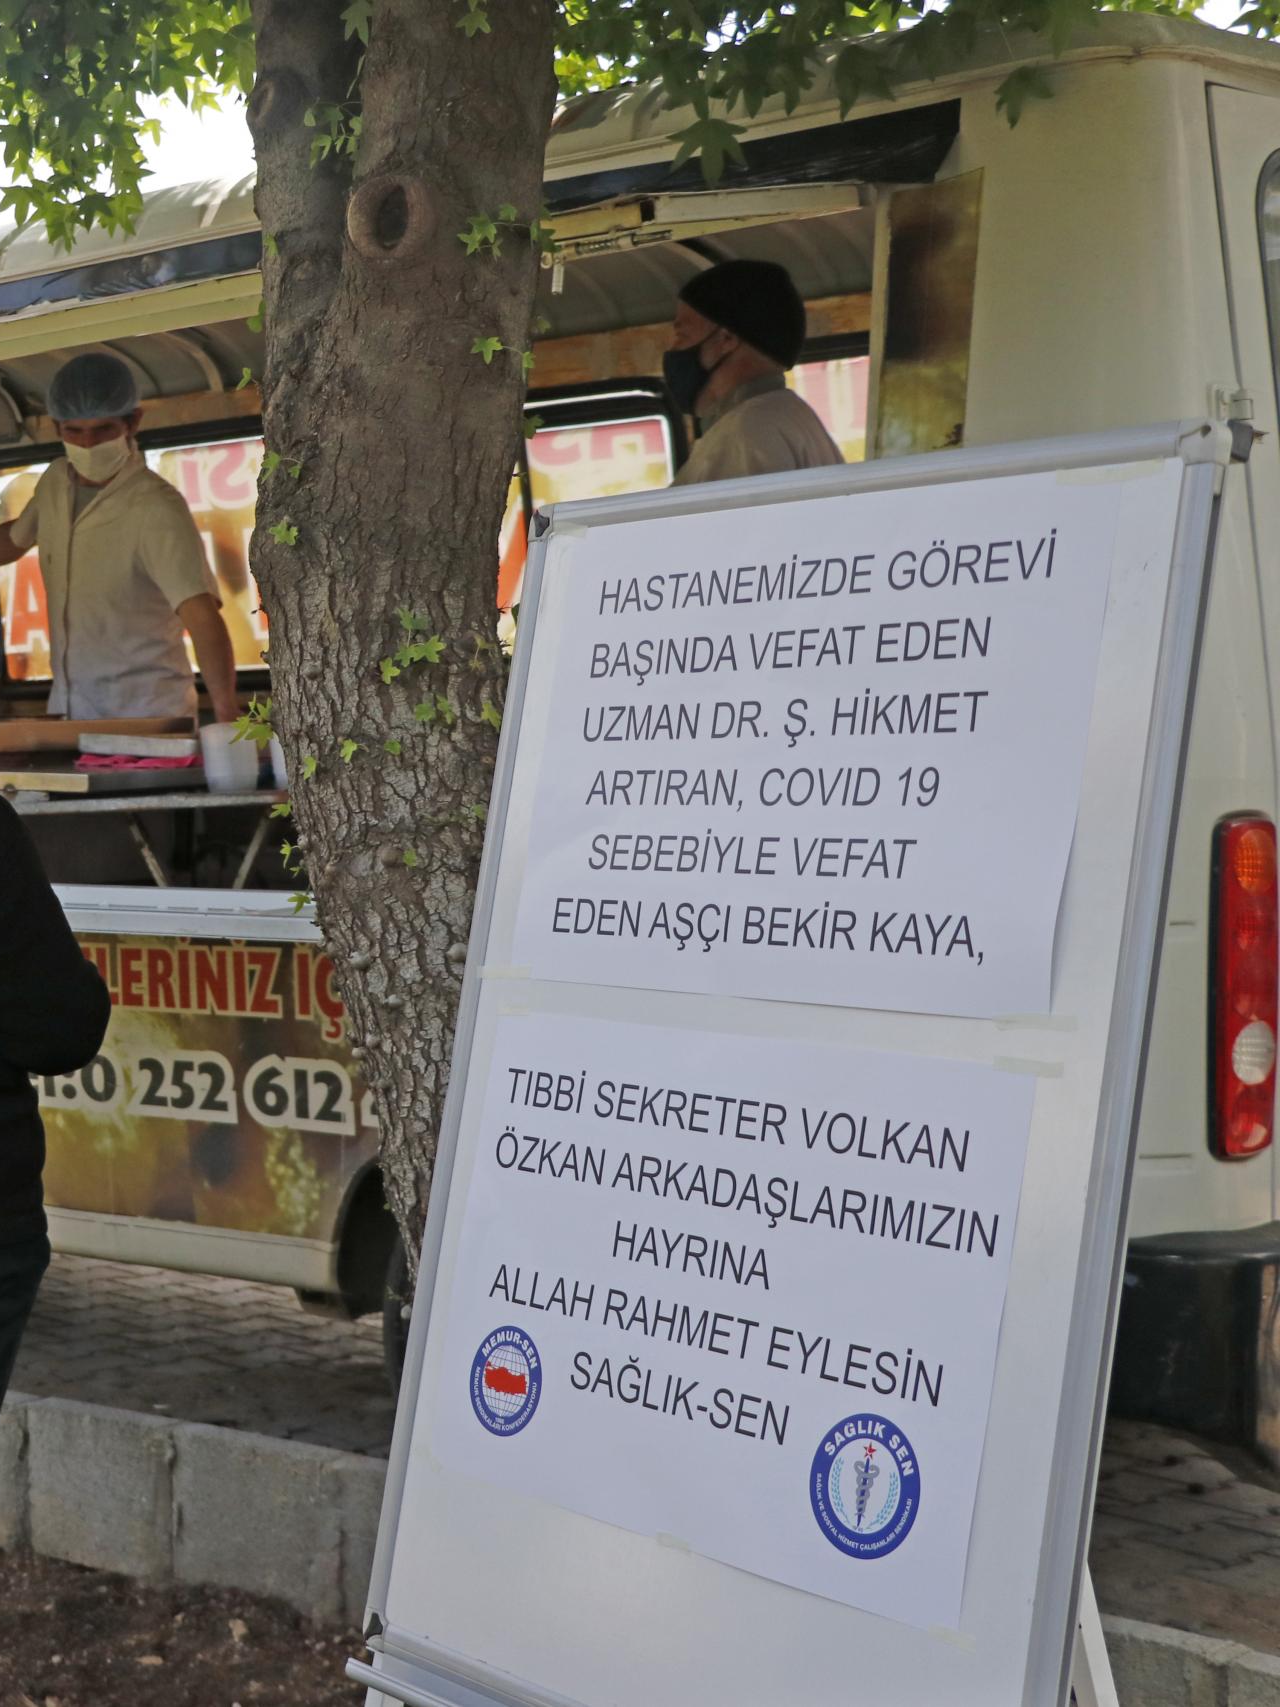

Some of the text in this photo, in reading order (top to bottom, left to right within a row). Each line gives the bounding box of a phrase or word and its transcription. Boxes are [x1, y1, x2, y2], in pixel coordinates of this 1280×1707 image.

[598, 527, 1058, 616] HASTANEMİZDE GÖREVİ
[589, 616, 992, 687] BAŞINDA VEFAT EDEN
[583, 687, 989, 749] UZMAN DR. Ş. HİKMET
[585, 766, 940, 812] ARTIRAN, COVID 19
[588, 828, 918, 880] SEBEBİYLE VEFAT
[552, 897, 984, 967] EDEN AŞÇI BEKİR KAYA,
[138, 1057, 230, 1113] 252
[252, 1065, 346, 1123] 612
[508, 1067, 970, 1173] TIBBİ SEKRETER VOLKAN
[495, 1125, 1000, 1257] ÖZKAN ARKADAŞLARIMIZIN
[612, 1220, 770, 1291] HAYRINA
[482, 1331, 538, 1369] MEMUR-SEN
[488, 1263, 944, 1408] ALLAH RAHMET EYLESİN
[570, 1351, 790, 1446] SAĞLIK-SEN
[824, 1420, 915, 1477] SAĞLIK SEN
